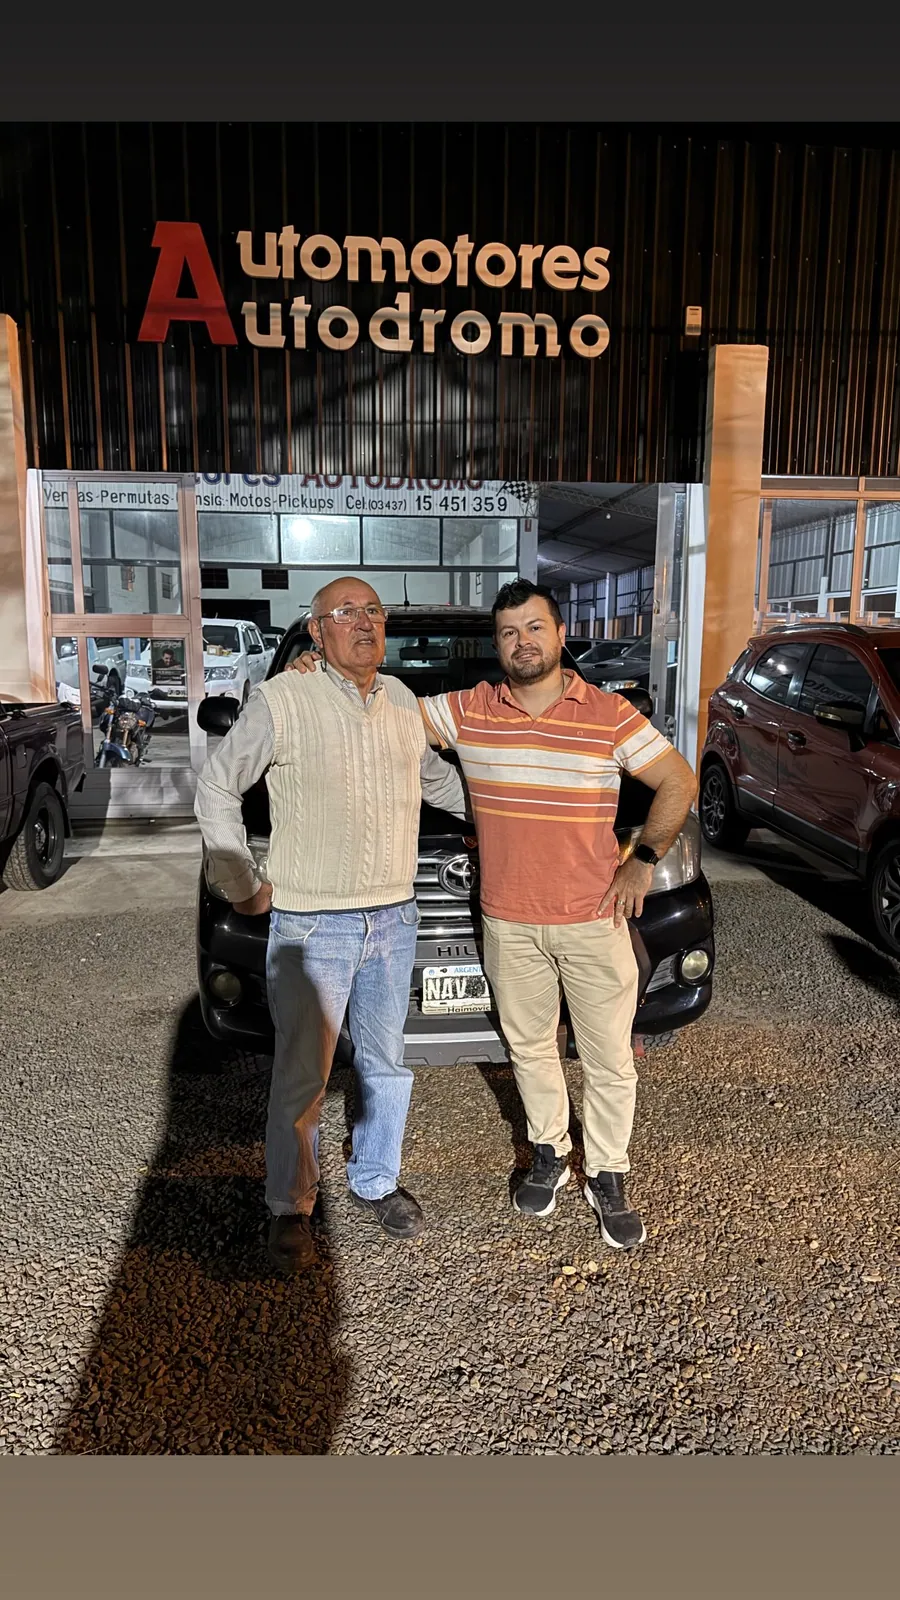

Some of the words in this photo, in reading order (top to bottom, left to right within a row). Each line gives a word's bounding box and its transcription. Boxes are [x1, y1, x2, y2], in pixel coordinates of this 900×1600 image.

[415, 495, 432, 511] 15
[439, 496, 466, 511] 451
[473, 496, 508, 512] 359
[426, 977, 467, 1001] NAV
